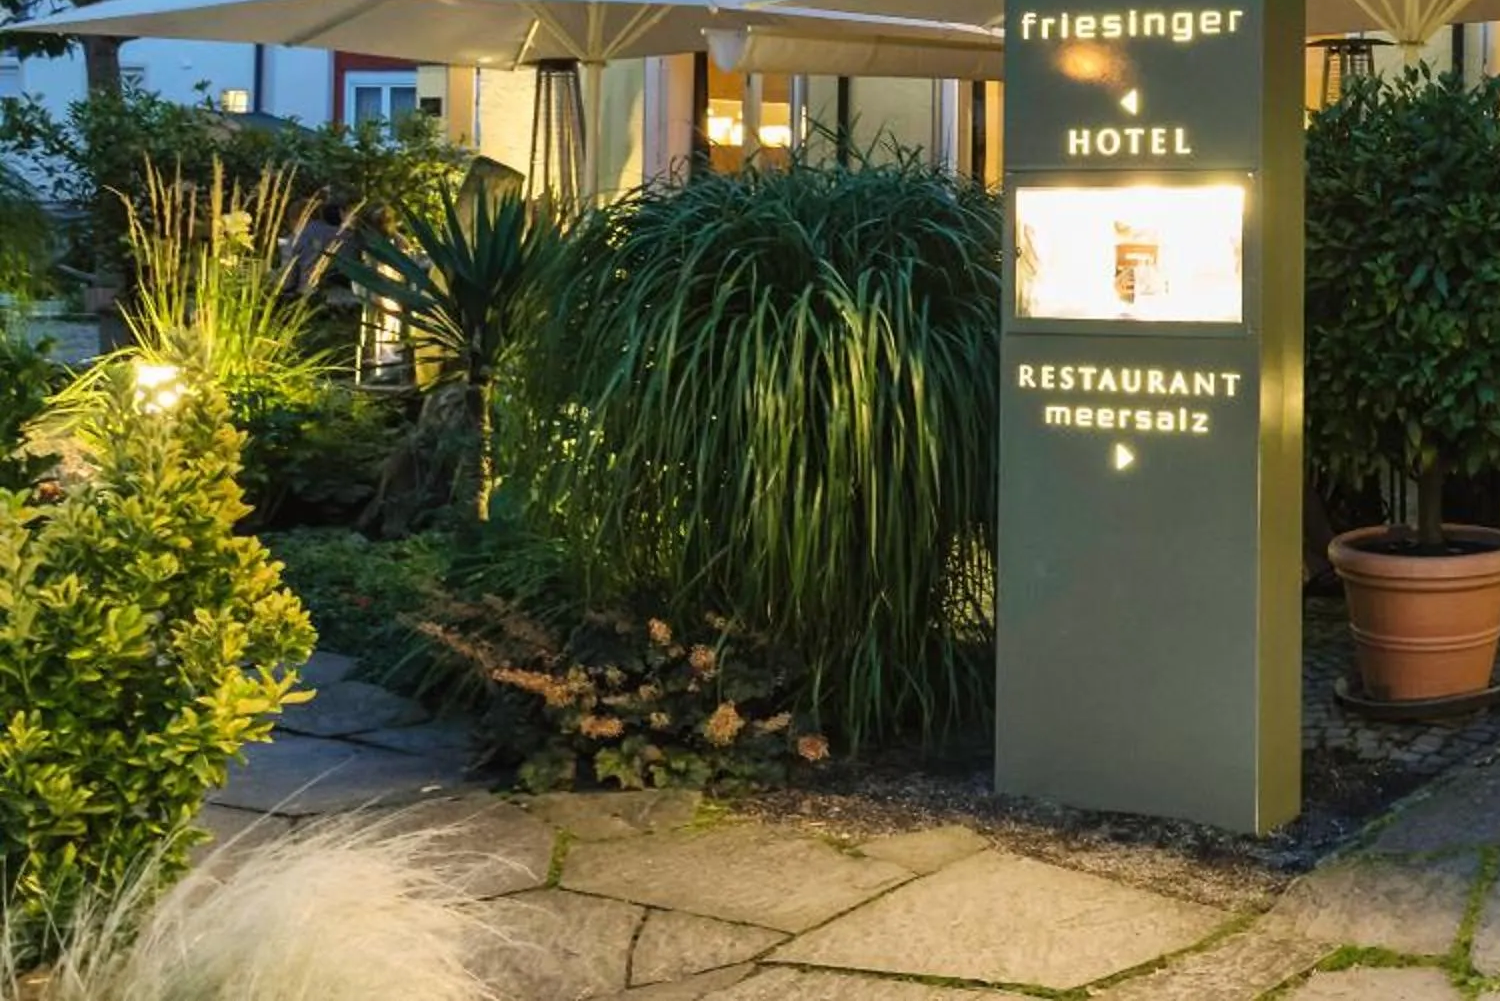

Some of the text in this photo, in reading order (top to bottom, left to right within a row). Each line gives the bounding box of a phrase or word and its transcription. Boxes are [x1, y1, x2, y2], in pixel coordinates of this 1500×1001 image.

[1021, 10, 1244, 42] friesinger
[1067, 128, 1192, 155] HOTEL
[1018, 365, 1241, 397] RESTAURANT
[1045, 405, 1209, 433] meersalz
